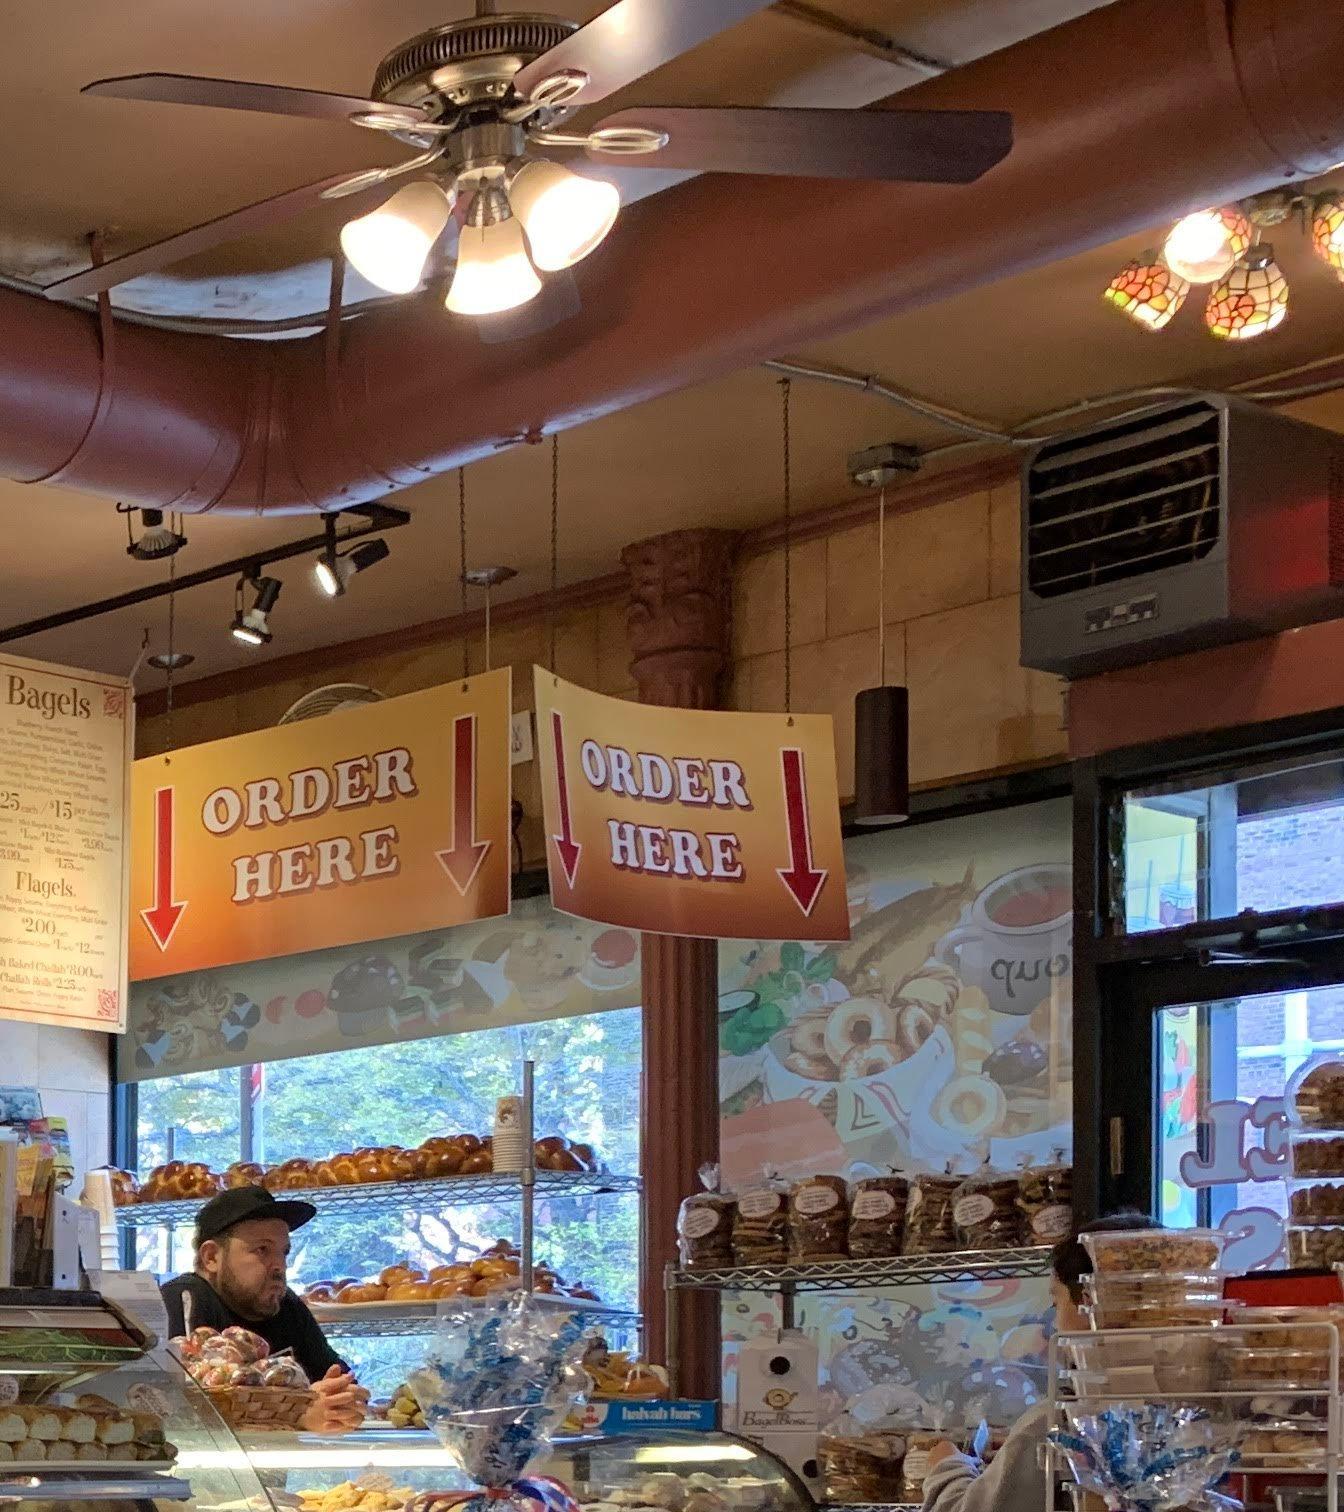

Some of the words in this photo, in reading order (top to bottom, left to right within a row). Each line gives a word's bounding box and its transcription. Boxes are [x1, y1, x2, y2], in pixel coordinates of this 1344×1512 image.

[6, 674, 92, 720] Bagels
[200, 747, 419, 839] ORDER
[580, 738, 753, 811] ORDER
[231, 824, 402, 906] HERE
[606, 818, 747, 883] HERE
[16, 870, 77, 899] Flagels.
[622, 1407, 666, 1421] halvah
[671, 1407, 703, 1420] bars
